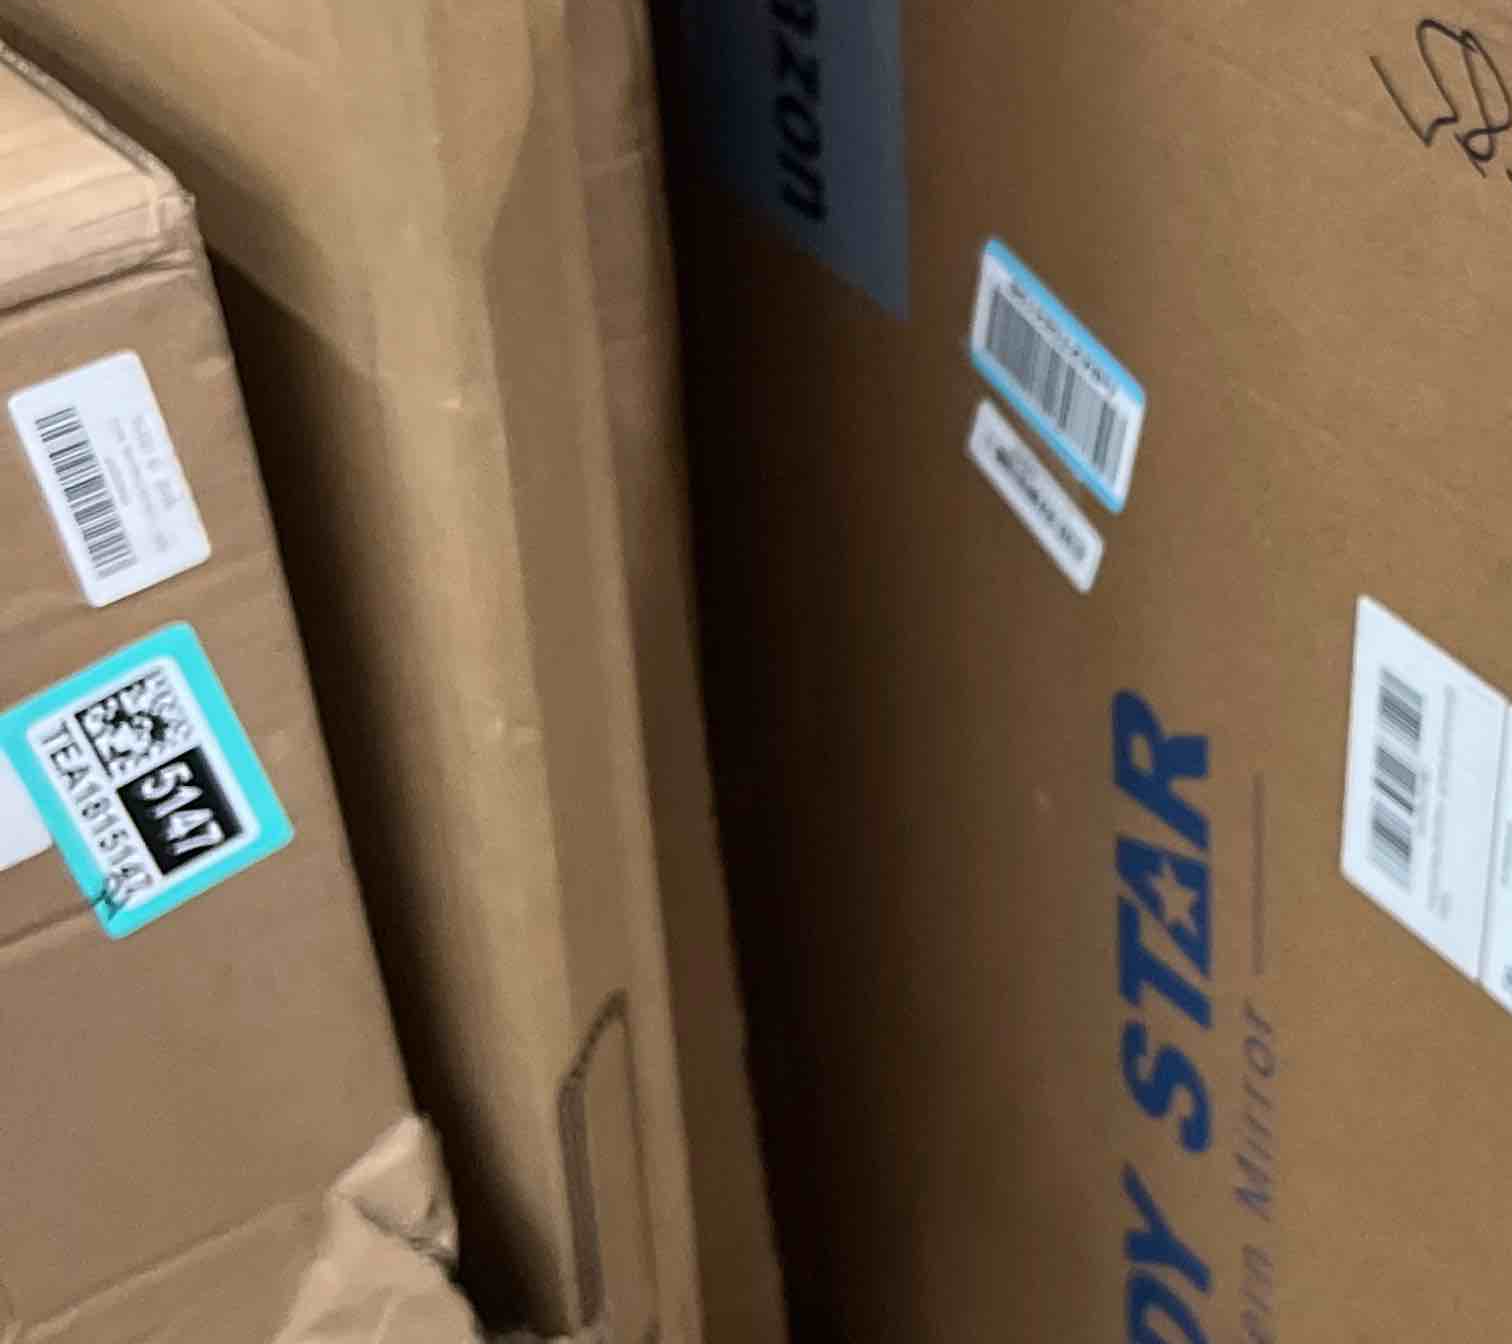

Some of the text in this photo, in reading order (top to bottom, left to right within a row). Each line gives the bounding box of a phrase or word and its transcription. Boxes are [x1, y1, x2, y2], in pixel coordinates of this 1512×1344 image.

[139, 758, 226, 859] 5147
[1111, 687, 1214, 1154] STAR
[1233, 998, 1279, 1224] Mirror
